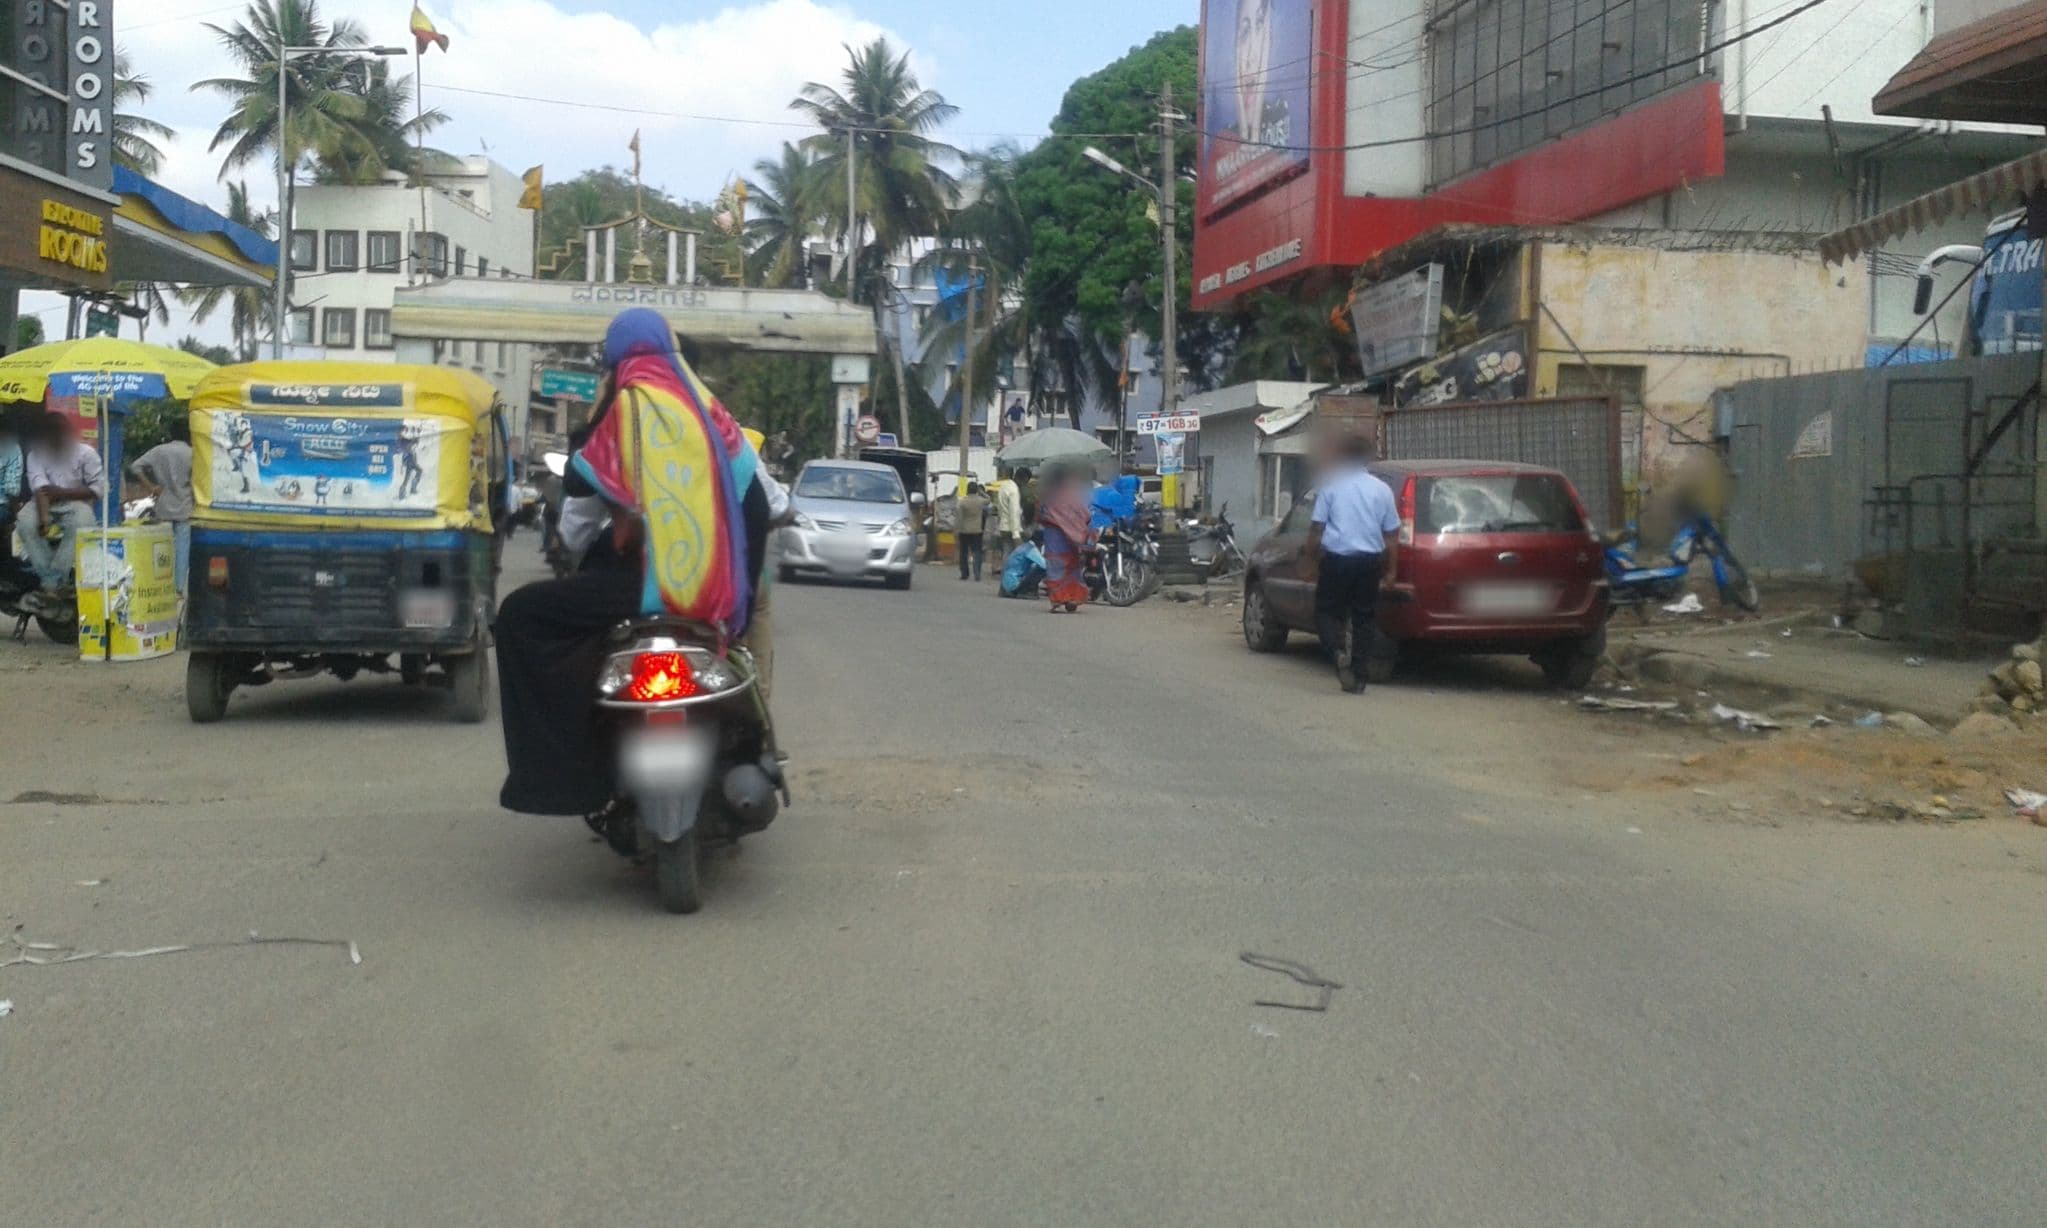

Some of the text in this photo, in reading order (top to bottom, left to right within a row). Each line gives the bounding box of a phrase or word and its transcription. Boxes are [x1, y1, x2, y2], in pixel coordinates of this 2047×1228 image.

[72, 2, 103, 168] ROOMS
[39, 225, 107, 272] ROOMS
[1, 382, 21, 393] 4G
[284, 417, 369, 437] Snow City
[1167, 418, 1186, 429] 1GB
